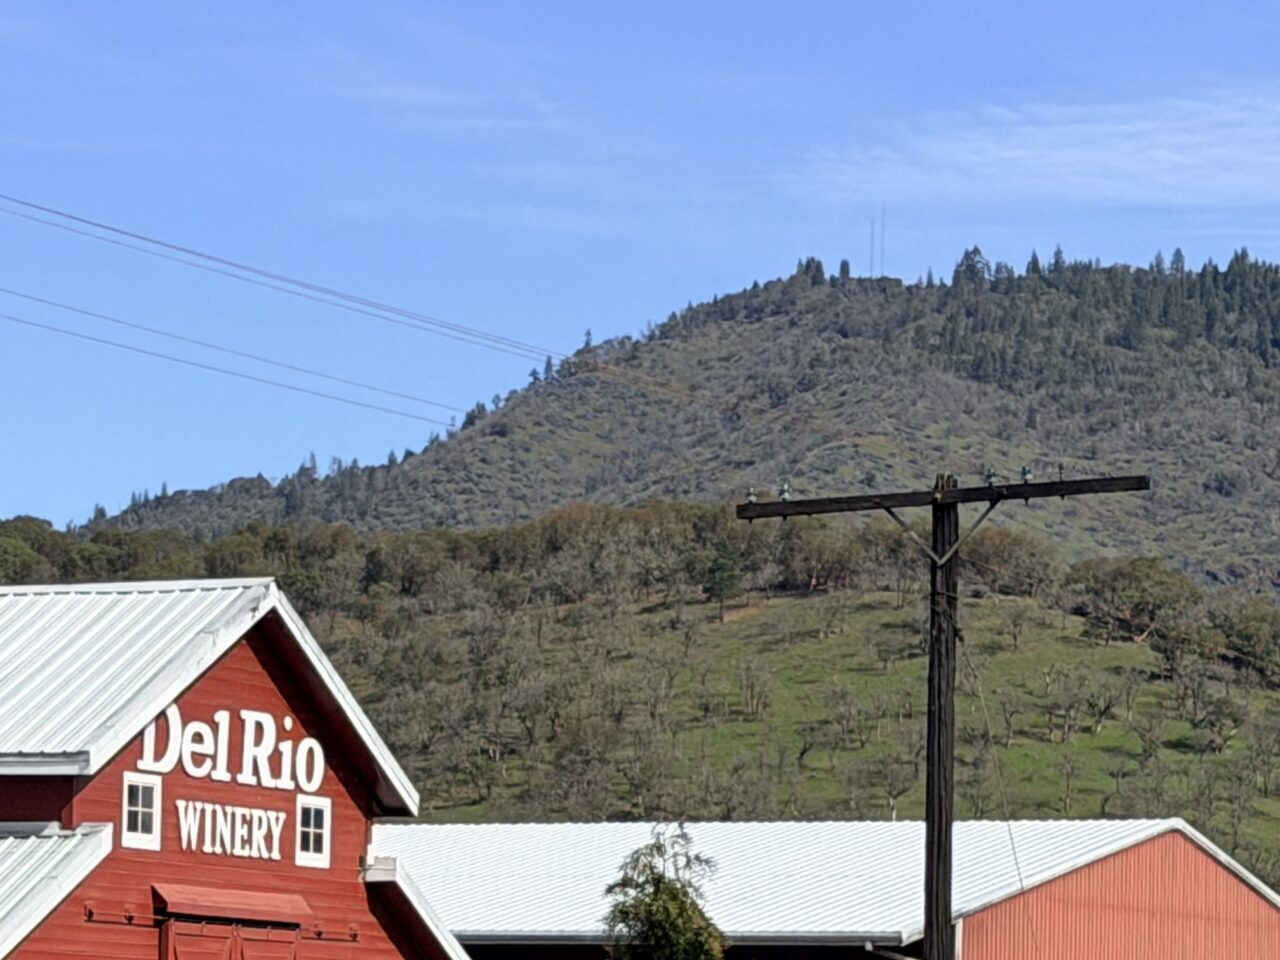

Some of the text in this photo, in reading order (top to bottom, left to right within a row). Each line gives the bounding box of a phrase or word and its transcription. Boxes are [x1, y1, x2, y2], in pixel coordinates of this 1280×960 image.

[136, 703, 325, 793] Del Rio
[175, 799, 287, 860] WINERY
